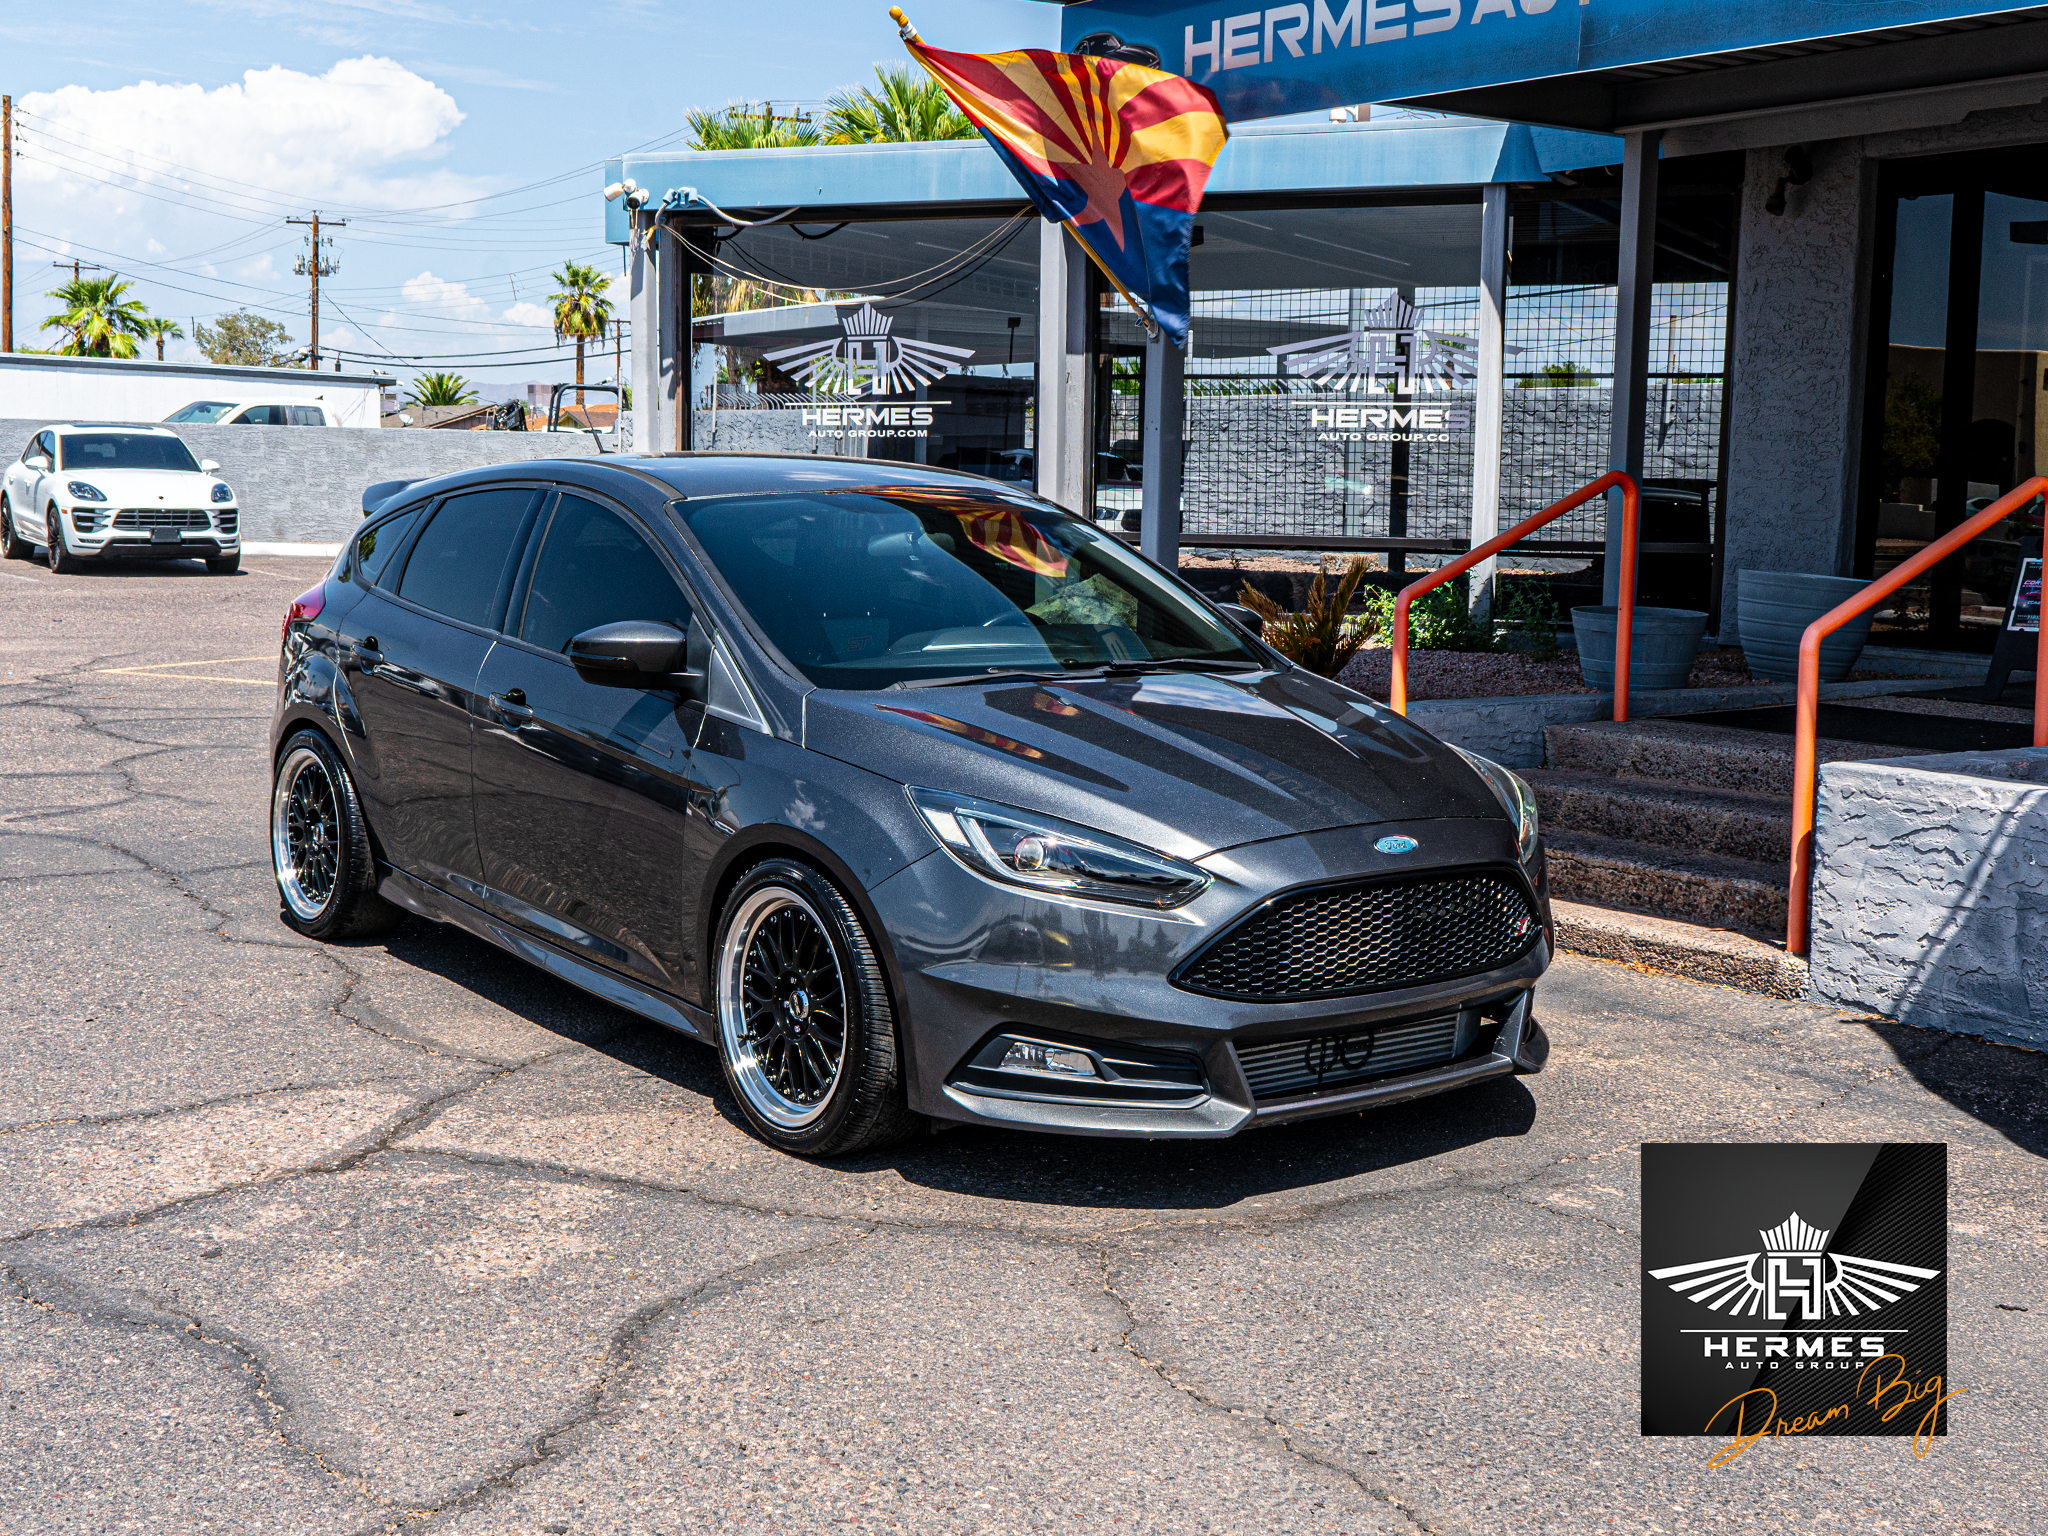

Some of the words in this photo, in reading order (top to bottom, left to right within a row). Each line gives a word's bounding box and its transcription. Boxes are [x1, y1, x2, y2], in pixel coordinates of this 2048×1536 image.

[1185, 0, 1463, 77] HERMES
[802, 407, 933, 426] HERMES
[1311, 408, 1470, 429] HERMES
[808, 429, 844, 438] AUTO
[847, 429, 928, 438] GROUP.COM
[1318, 432, 1362, 442] AUTO
[1384, 840, 1408, 850] Ford
